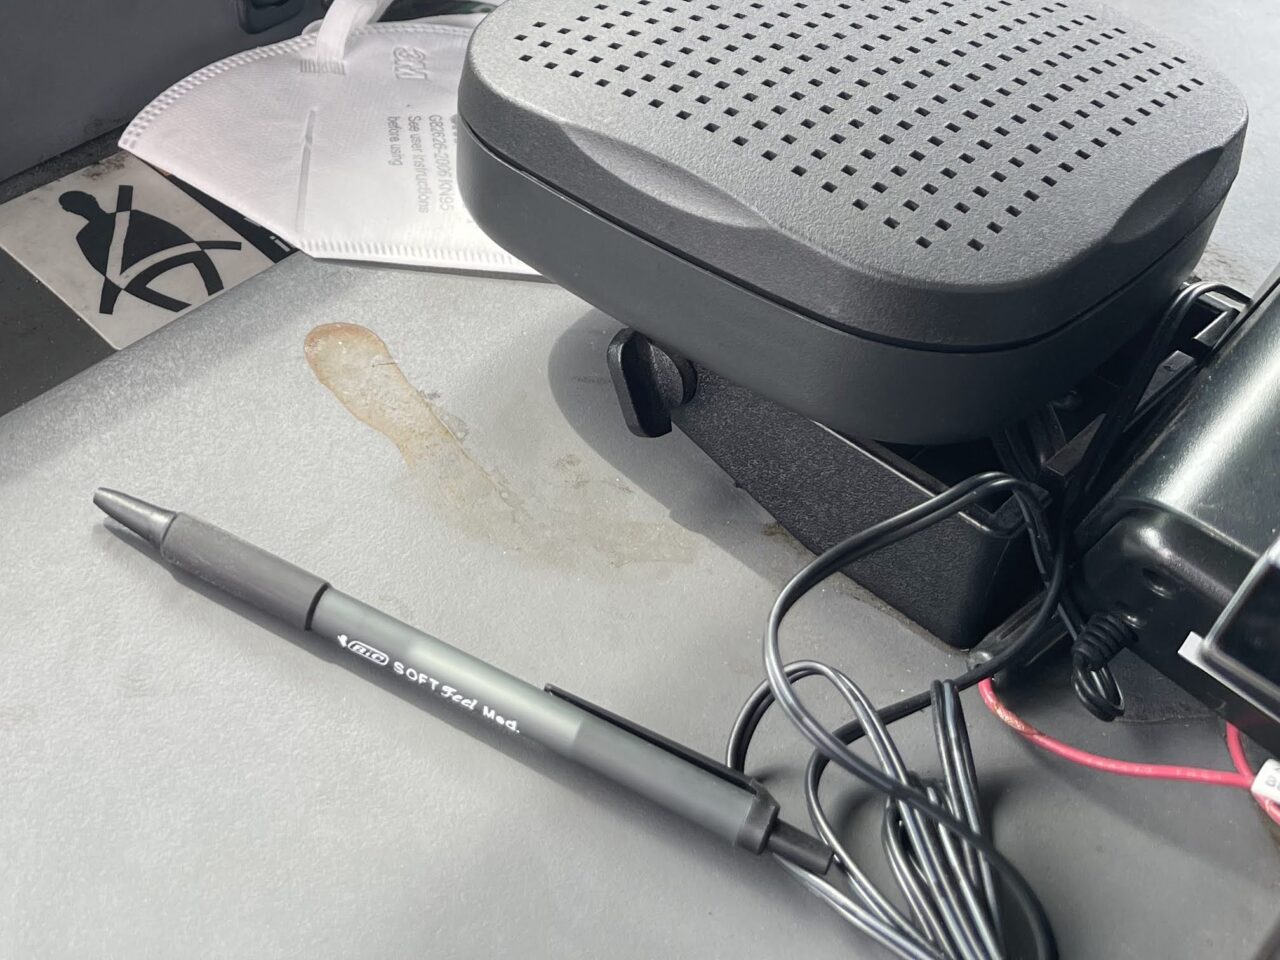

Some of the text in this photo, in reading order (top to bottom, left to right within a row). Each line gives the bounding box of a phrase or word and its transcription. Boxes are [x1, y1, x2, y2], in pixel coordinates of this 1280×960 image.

[408, 116, 421, 132] See
[387, 116, 403, 166] before using
[410, 134, 423, 153] user
[438, 179, 454, 212] KN95
[393, 661, 439, 691] SOFT
[441, 684, 478, 710] Feel
[483, 705, 520, 734] Med.
